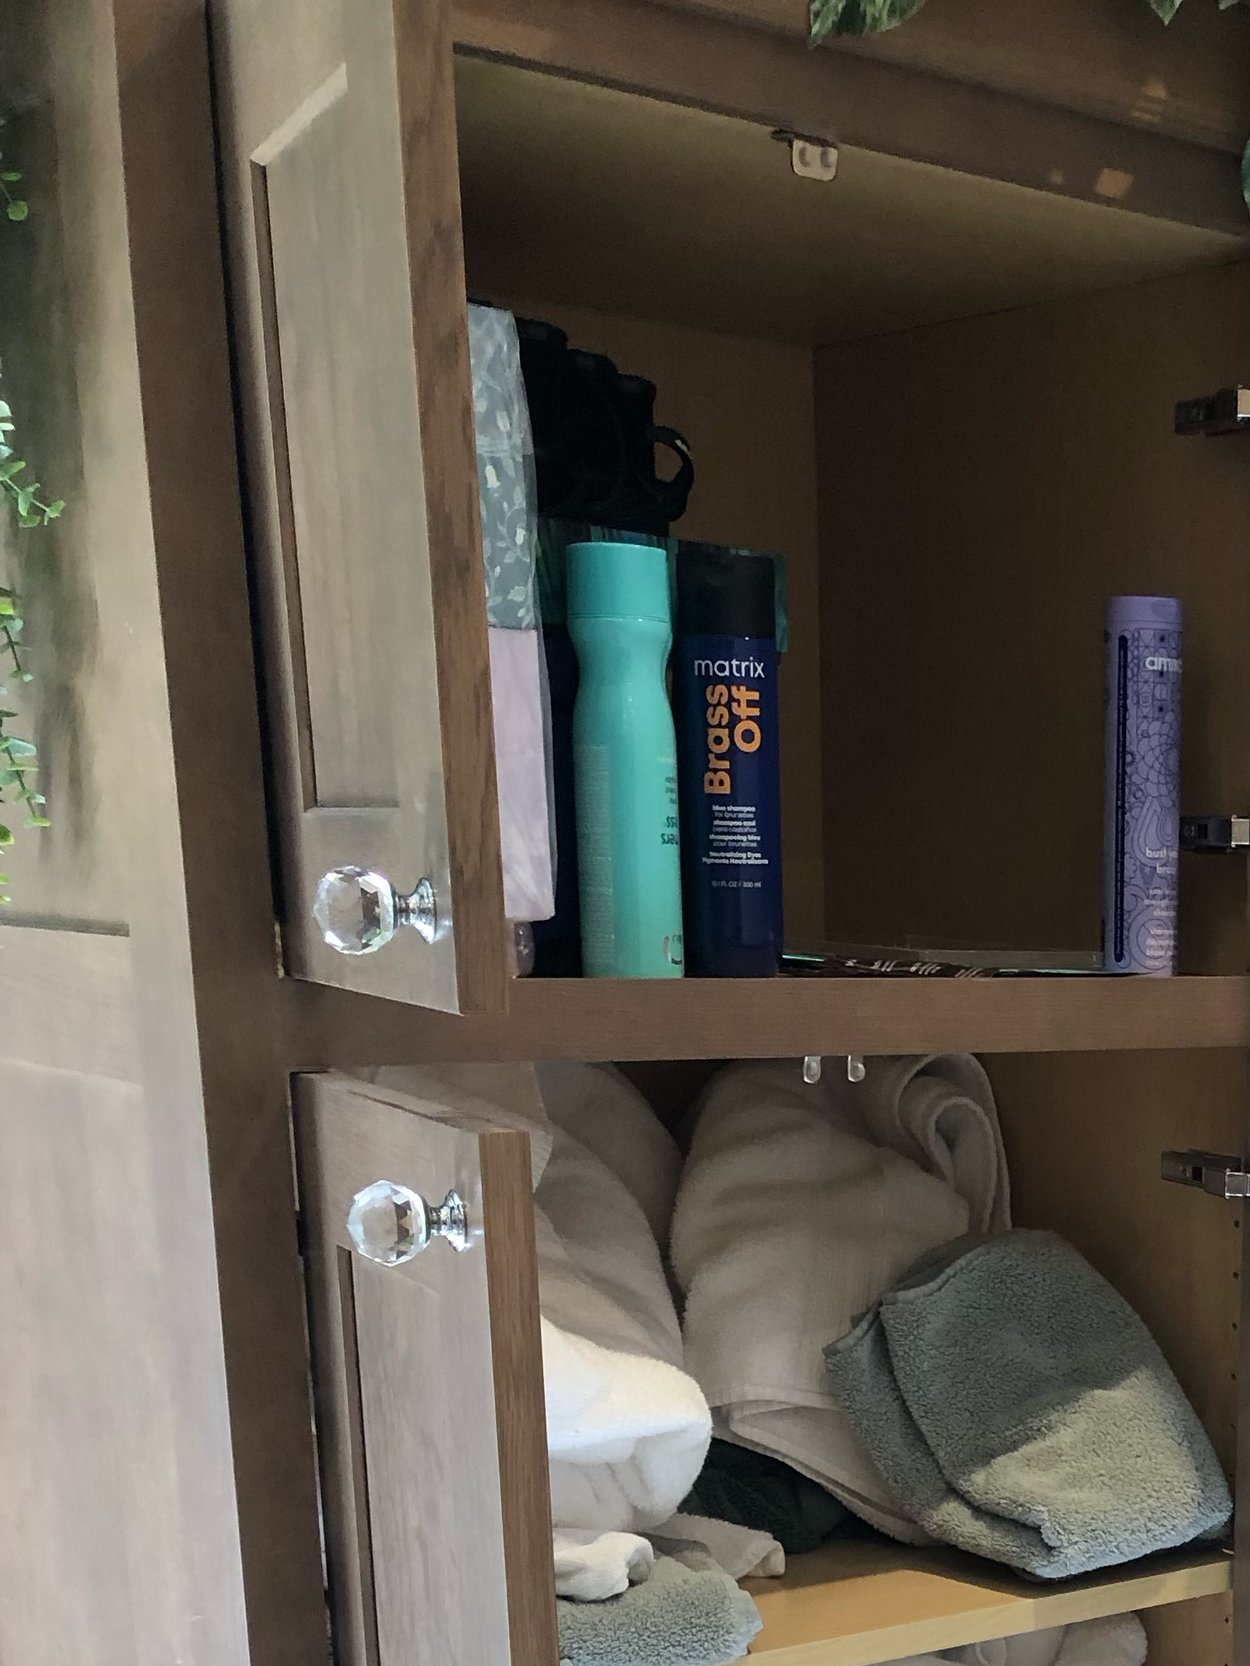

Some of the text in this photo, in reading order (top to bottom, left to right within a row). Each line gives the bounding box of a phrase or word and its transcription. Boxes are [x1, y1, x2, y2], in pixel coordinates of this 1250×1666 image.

[694, 656, 765, 678] matrix
[704, 684, 761, 794] Brass Off
[726, 805, 756, 813] shampoo
[1146, 847, 1167, 858] bust
